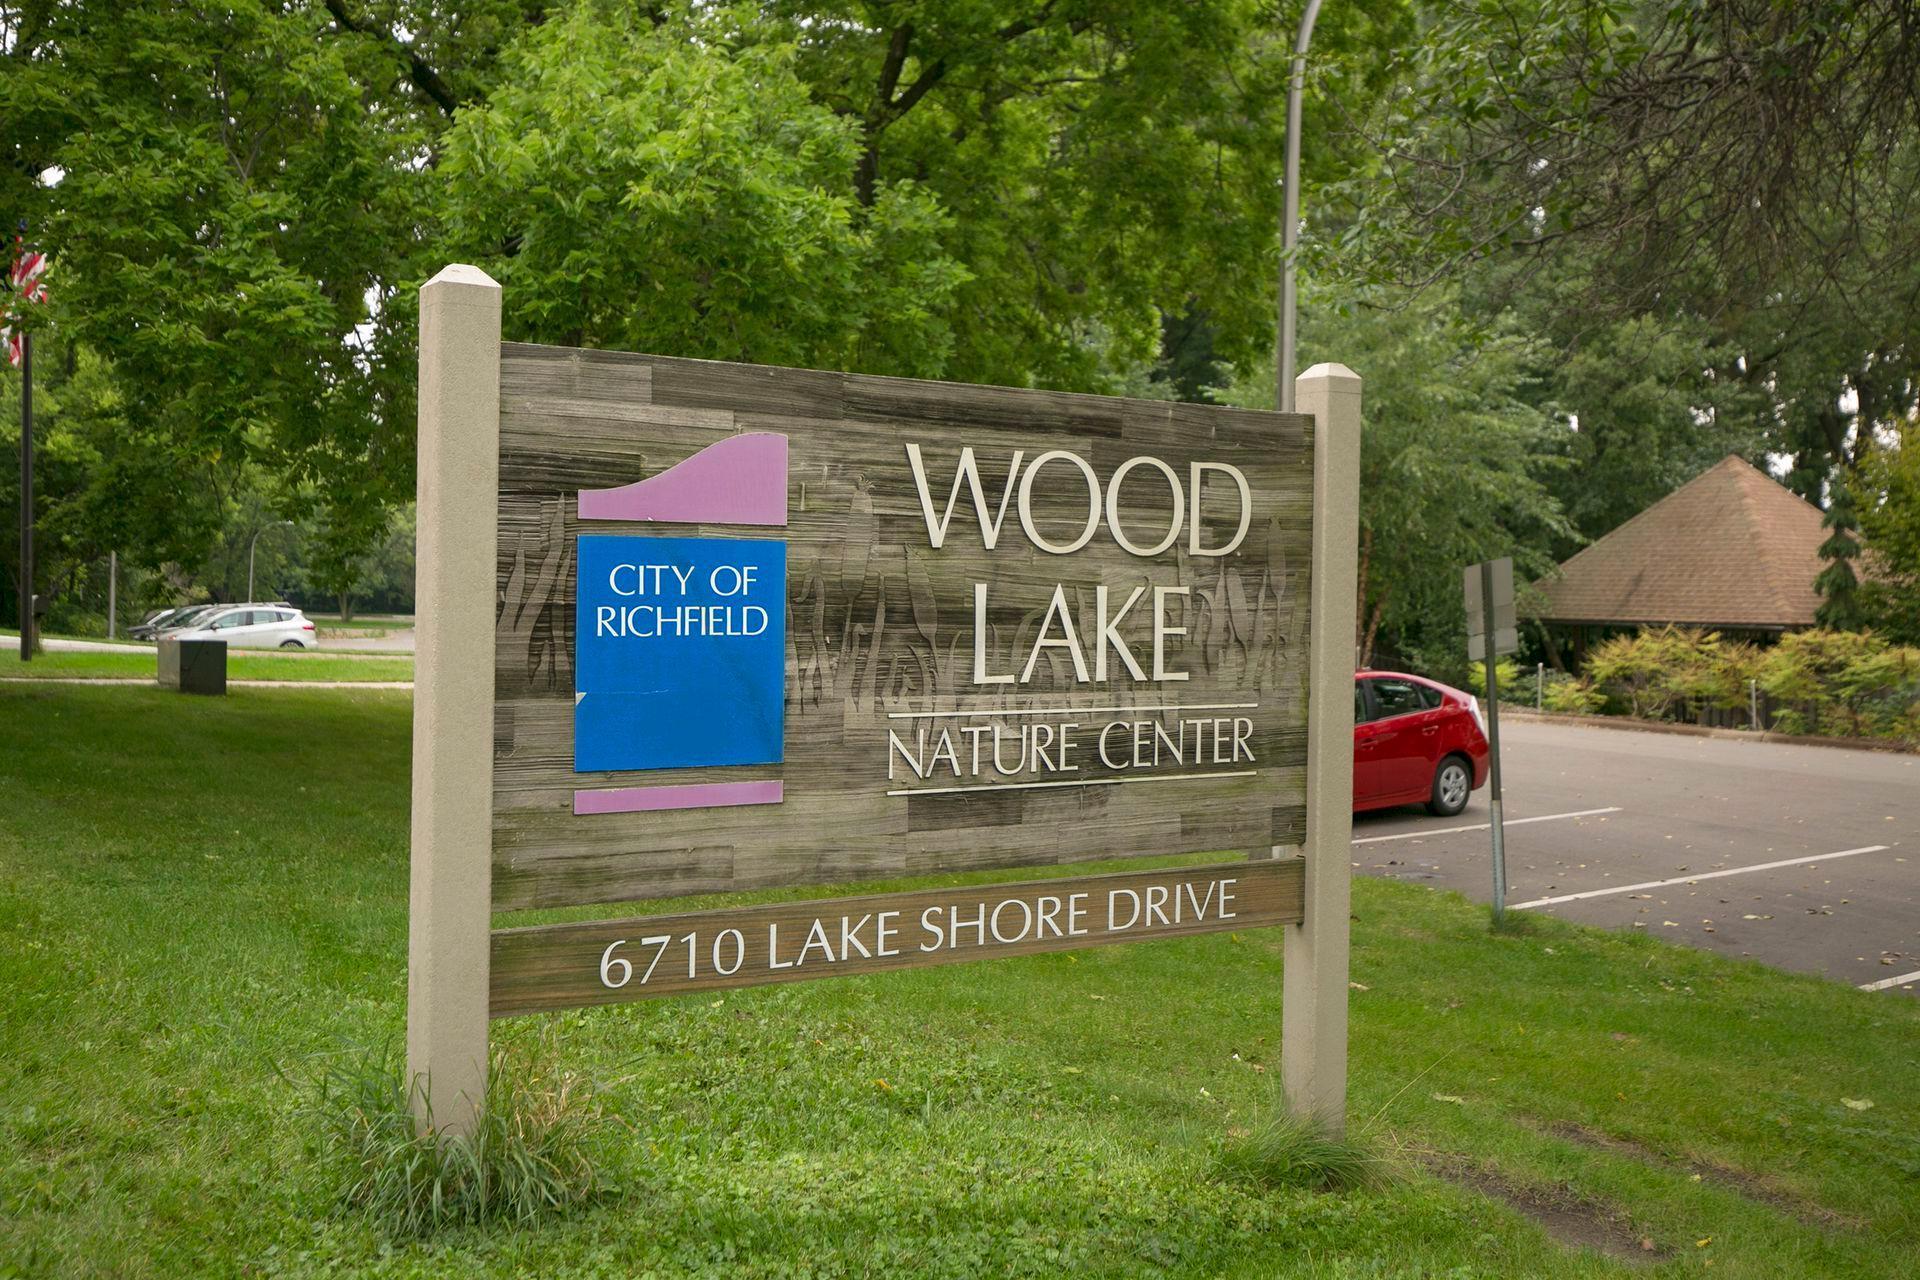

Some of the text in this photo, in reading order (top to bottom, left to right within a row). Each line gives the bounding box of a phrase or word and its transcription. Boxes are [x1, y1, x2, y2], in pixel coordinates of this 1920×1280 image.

[906, 442, 1252, 557] WOOD
[596, 605, 769, 637] RICHFIELD
[608, 564, 758, 597] CITY OF
[973, 583, 1190, 685] LAKE
[888, 717, 1256, 780] NATURE CENTER
[598, 878, 1239, 990] 6710 LAKE SHORE DRIVE
